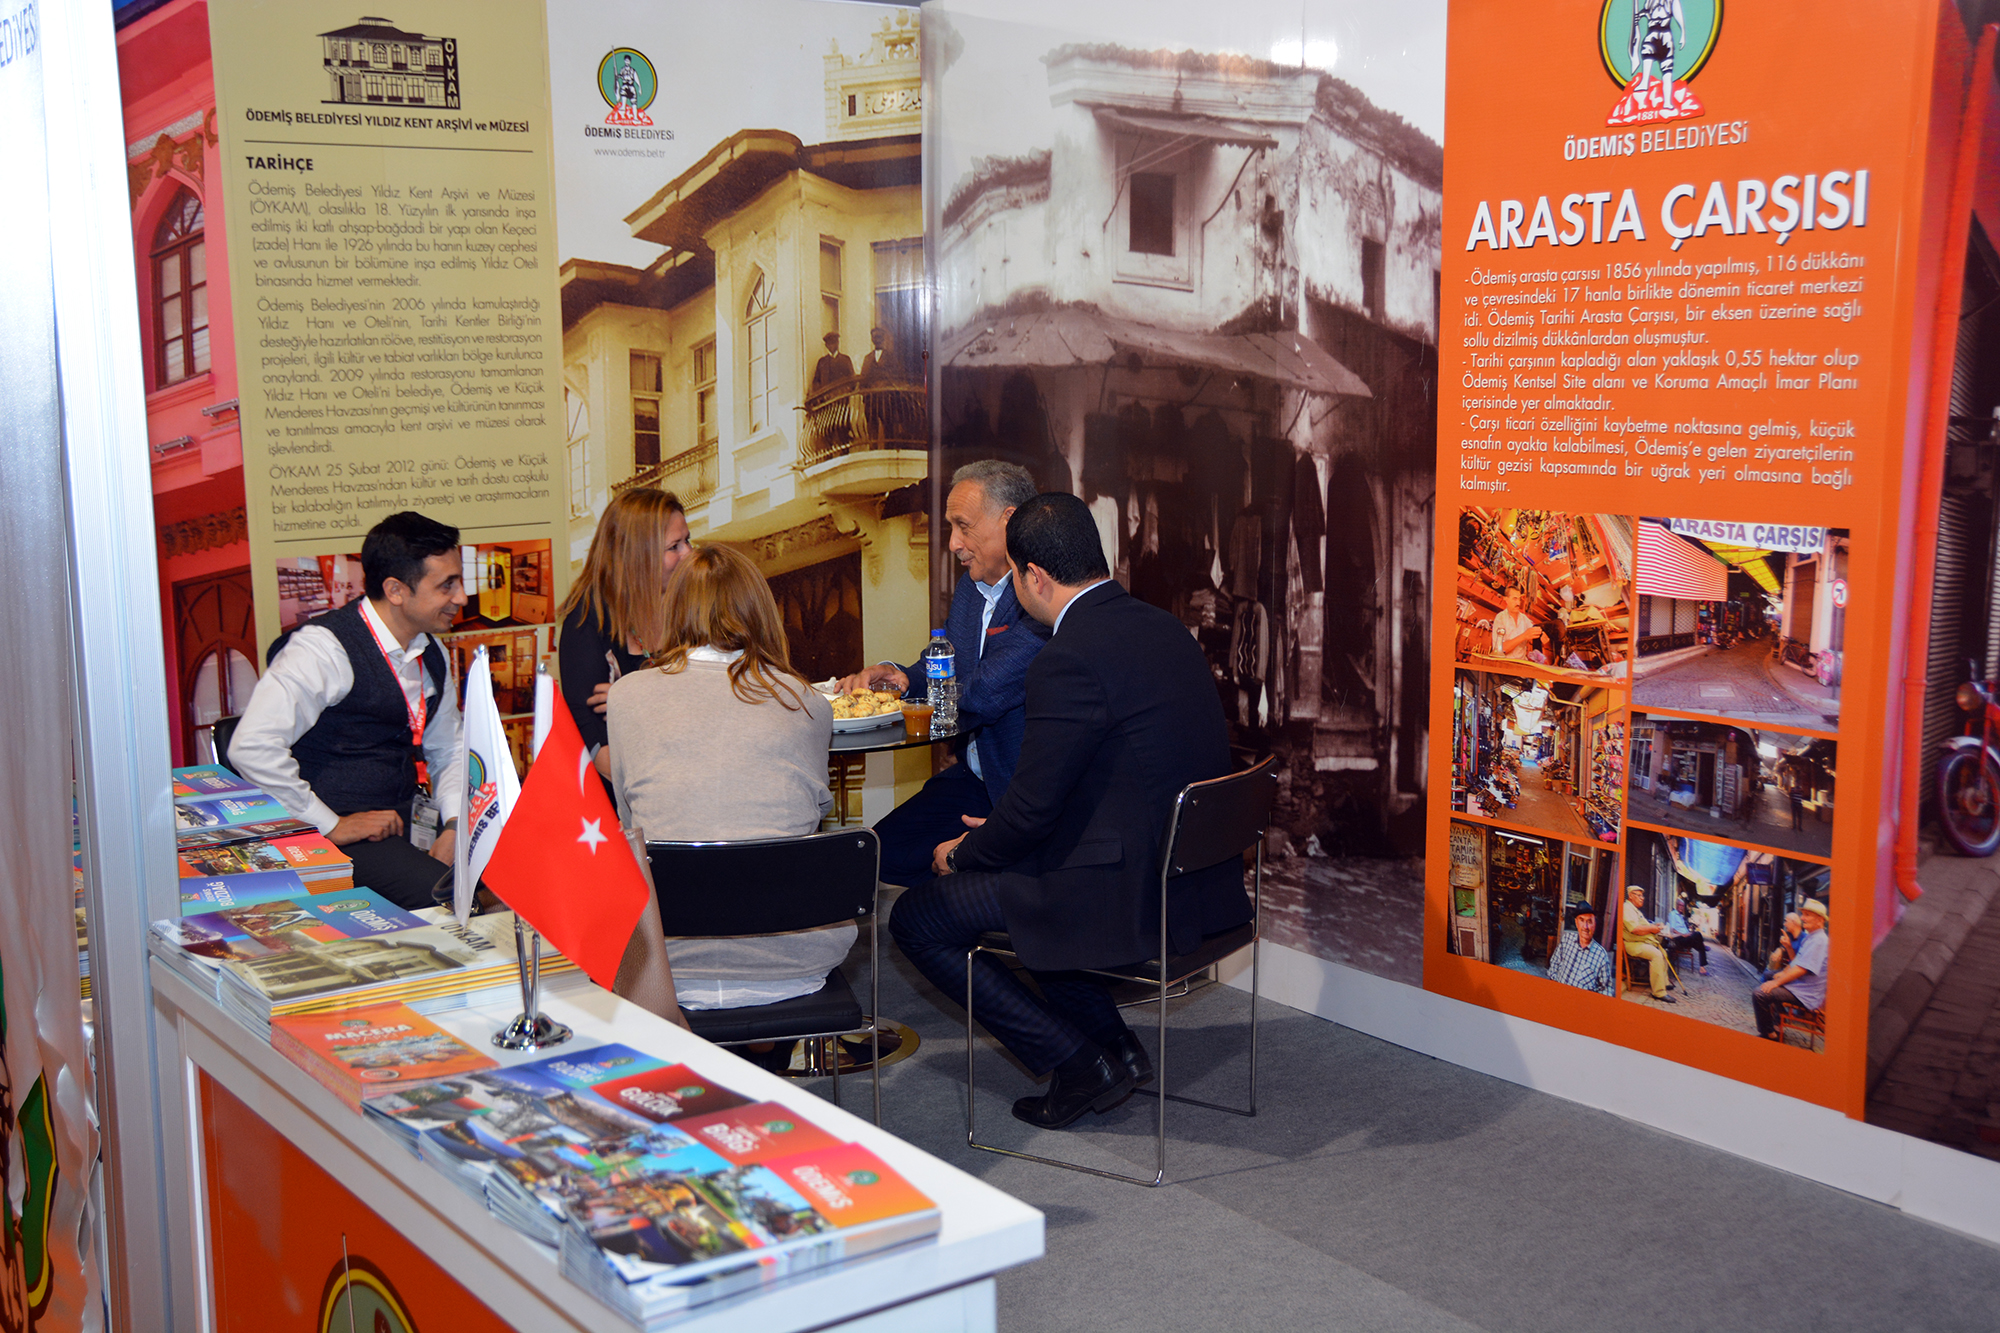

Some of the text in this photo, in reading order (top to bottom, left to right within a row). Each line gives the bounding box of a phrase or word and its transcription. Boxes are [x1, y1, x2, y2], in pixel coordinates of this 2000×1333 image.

[445, 38, 459, 109] ÖYKAM
[246, 108, 292, 125] ÖDEMİŞ
[295, 112, 361, 125] BELEDİYESİ
[364, 116, 401, 127] YILDIZ
[404, 118, 432, 128] KENT
[436, 118, 472, 132] ARŞİVİ
[489, 120, 528, 132] MÜZESİ
[1637, 110, 1659, 120] 1881
[246, 153, 312, 173] TARİHÇE
[248, 179, 534, 201] Ödemiş Belediyesi Yıldız Kent Arşivi ve Müzesi
[318, 201, 365, 215] olasılıkla
[398, 203, 438, 219] Yüzyılın
[445, 203, 456, 216] ilk
[462, 204, 509, 220] yarısında
[515, 207, 535, 219] inşa
[1464, 170, 1868, 252] ARASTA ÇARŞISI
[255, 273, 311, 286] binasında
[316, 273, 352, 286] hizmet
[1471, 268, 1516, 286] Ödemiş
[1520, 270, 1558, 283] arasta
[1560, 269, 1600, 283] çarsısı
[1606, 262, 1641, 278] 1856
[1644, 259, 1691, 281] yılında
[1767, 254, 1797, 271] 116
[1801, 251, 1864, 270] dükkânı
[1464, 275, 1863, 310] ve çevresindeki 17 hanla birlikte dönemin ticaret merkezi
[257, 296, 304, 312] Ödemiş
[392, 297, 425, 310] 2006
[431, 297, 465, 312] yılında
[472, 296, 540, 313] kamulaştırdığı
[1464, 298, 1862, 327] idi. Ödemiş Tarihi Arasta Çarşısı, bir eksen üzerine sağlı
[1463, 328, 1708, 348] sollu dizilmiş dükkânlardan oluşmuştur.
[1470, 348, 1860, 371] Tarihi çarşının kapladığı alan yaklaşık 0,55 hektar olup
[329, 368, 363, 381] 2009
[369, 367, 404, 384] yılında
[410, 369, 474, 381] restorasyonu
[480, 367, 543, 378] tamamlanan
[1462, 370, 1857, 392] Ödemiş Kentsel Site alanı ve Koruma Amaçlı İmar Planı
[1462, 393, 1614, 413] içerisinde yer almaktadır.
[1469, 414, 1855, 440] Çarşı ticari özelliğini kaybetme noktasına gelmiş, küçük
[1461, 434, 1854, 463] esnafın ayakta kalabilmesi, Ödemiş'e gelen ziyaretçilerin
[1461, 454, 1852, 489] kültür gezisi kapsamında bir uğrak yeri olmasına bağlı
[272, 486, 549, 514] bir kalabalığın katılımıyla ziyaretçi ve araştırmacıların
[273, 518, 326, 531] hizmetine
[1672, 518, 1746, 542] ARASTA
[325, 1024, 414, 1041] MACERA
